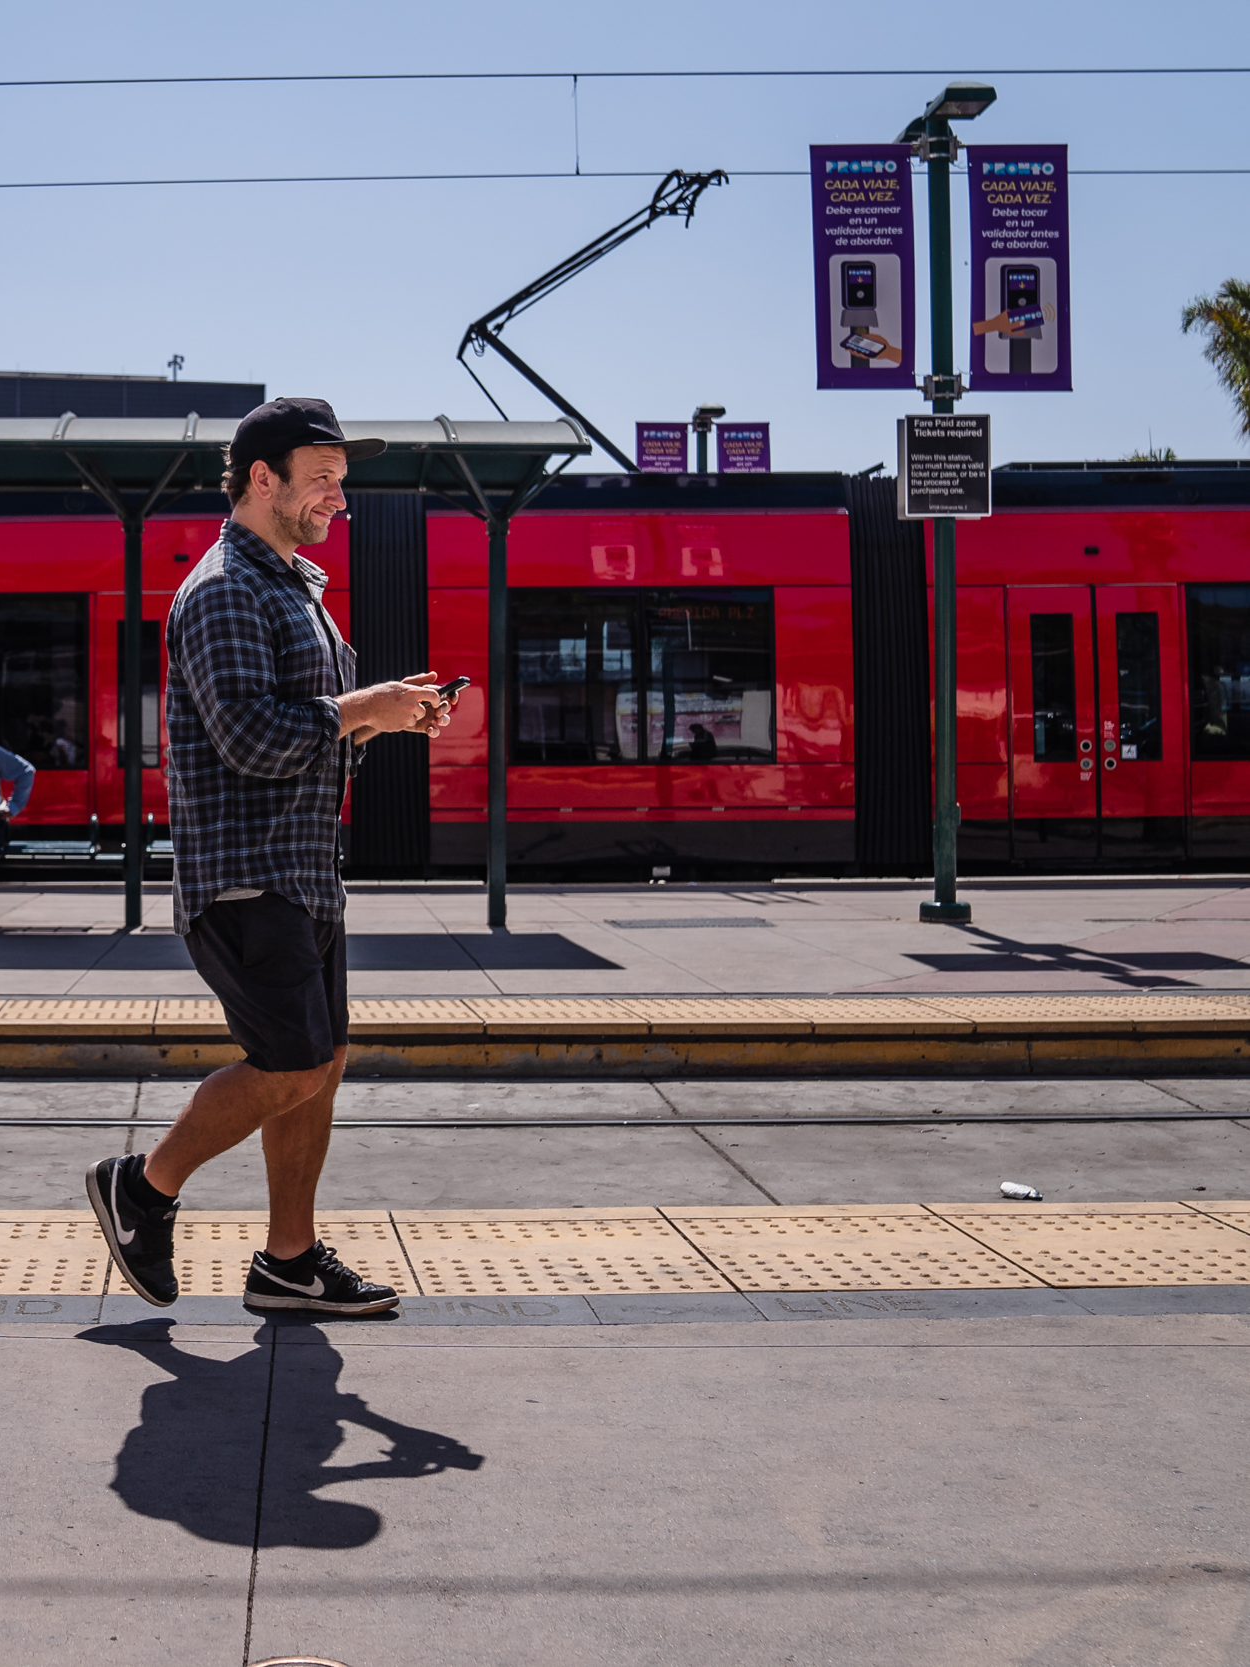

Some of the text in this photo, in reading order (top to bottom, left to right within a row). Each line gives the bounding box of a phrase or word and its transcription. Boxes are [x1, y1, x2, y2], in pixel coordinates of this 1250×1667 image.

[826, 160, 897, 174] PRONTO
[982, 162, 1054, 175] PRONTO
[824, 179, 900, 190] CADA VIAJE,
[982, 181, 1056, 193] CADA VIAJE,
[830, 192, 895, 202] CADA VEZ.
[987, 194, 1051, 204] CADA VEZ.
[826, 206, 901, 214] Debe escanear
[992, 208, 1048, 217] Debe tocar
[825, 226, 903, 236] validador antes
[982, 228, 1059, 238] validador antes
[835, 237, 893, 245] de abordar.
[992, 240, 1049, 249] de abordar.
[914, 419, 933, 427] Fare
[935, 419, 954, 427] Paid
[914, 428, 982, 438] Tickets required
[948, 454, 972, 462] station,
[911, 463, 924, 471] you
[944, 462, 960, 470] have
[911, 487, 948, 496] purchasing
[658, 606, 754, 619] AMERICA PLZ
[774, 1296, 937, 1312] LINE
[399, 1301, 560, 1318] HIND
